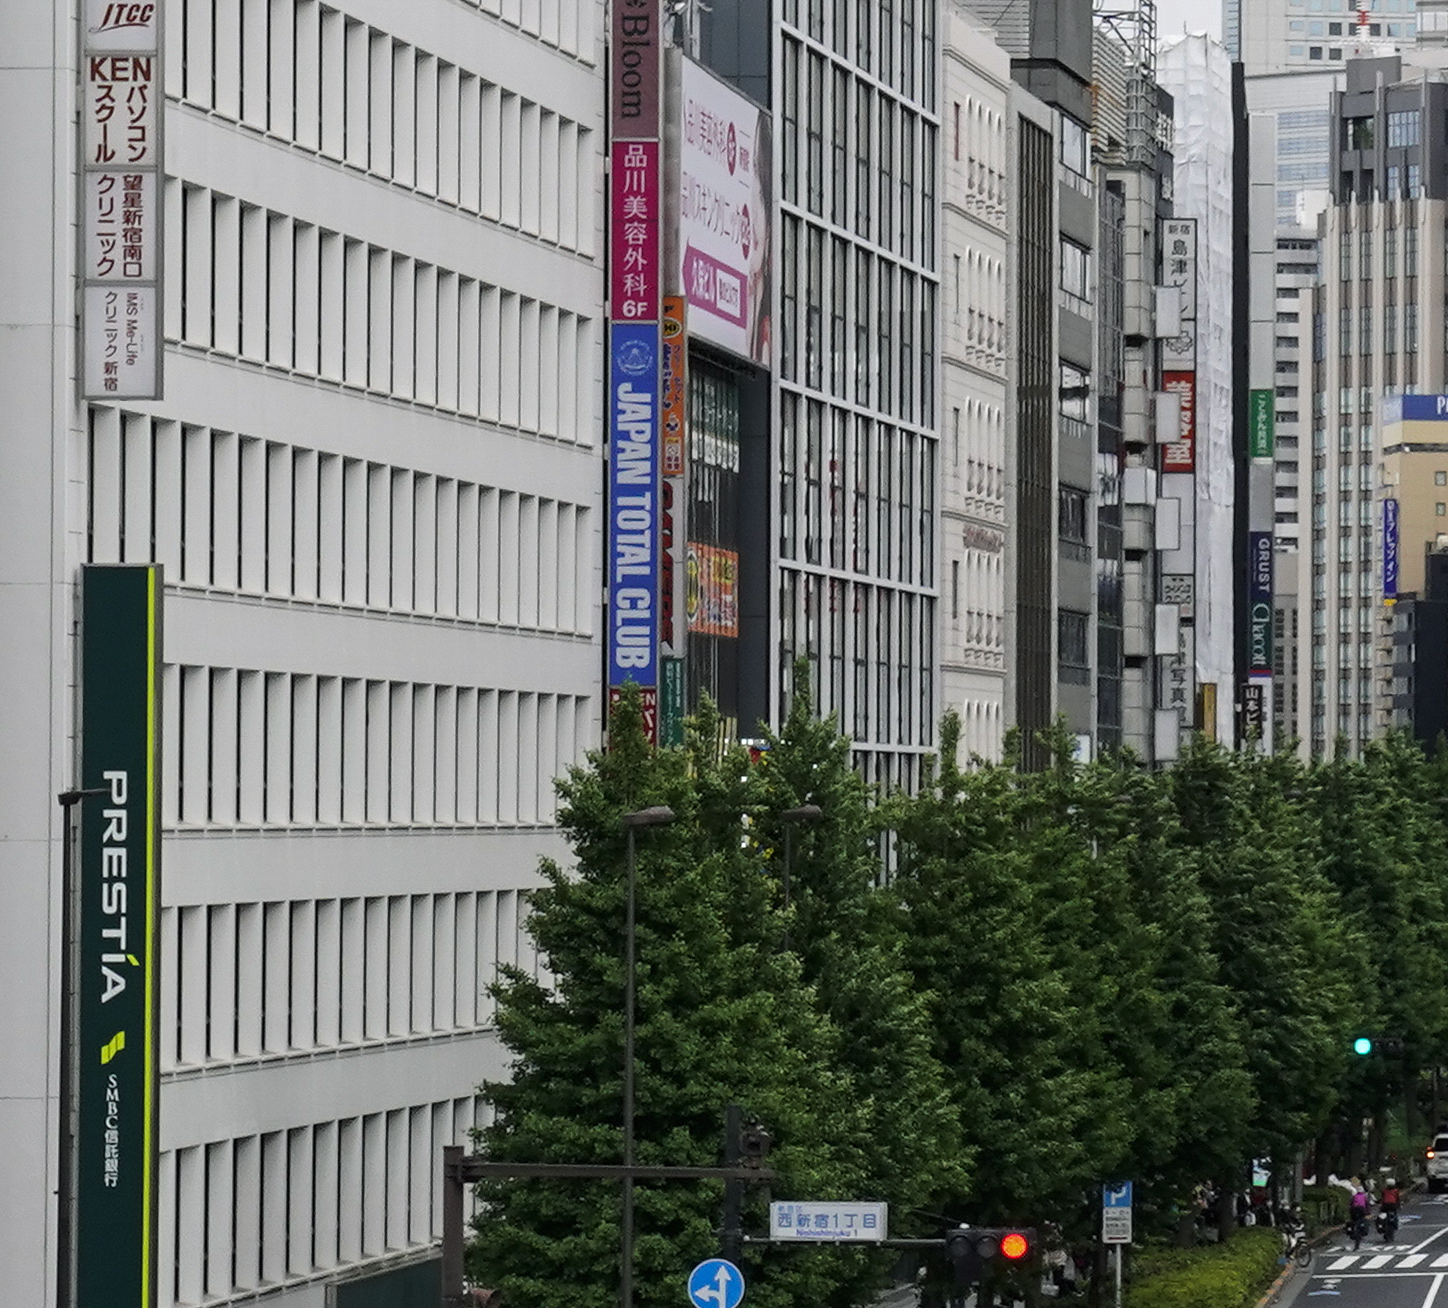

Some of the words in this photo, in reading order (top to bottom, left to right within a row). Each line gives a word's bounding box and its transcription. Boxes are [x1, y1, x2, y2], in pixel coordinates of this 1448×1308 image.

[89, 56, 152, 83] KEN
[620, 13, 651, 121] Bloom
[94, 84, 115, 164] スクール
[126, 84, 149, 164] パソコン
[96, 174, 116, 278] クリニック
[122, 174, 143, 278] 望星新宿南口
[621, 144, 649, 298] 品川美容外科
[622, 300, 649, 318] 6F
[616, 382, 652, 485] JAPAN
[616, 491, 652, 584] TOTAL
[615, 589, 651, 670] CLUB
[778, 1213, 877, 1229] 西新宿1丁目
